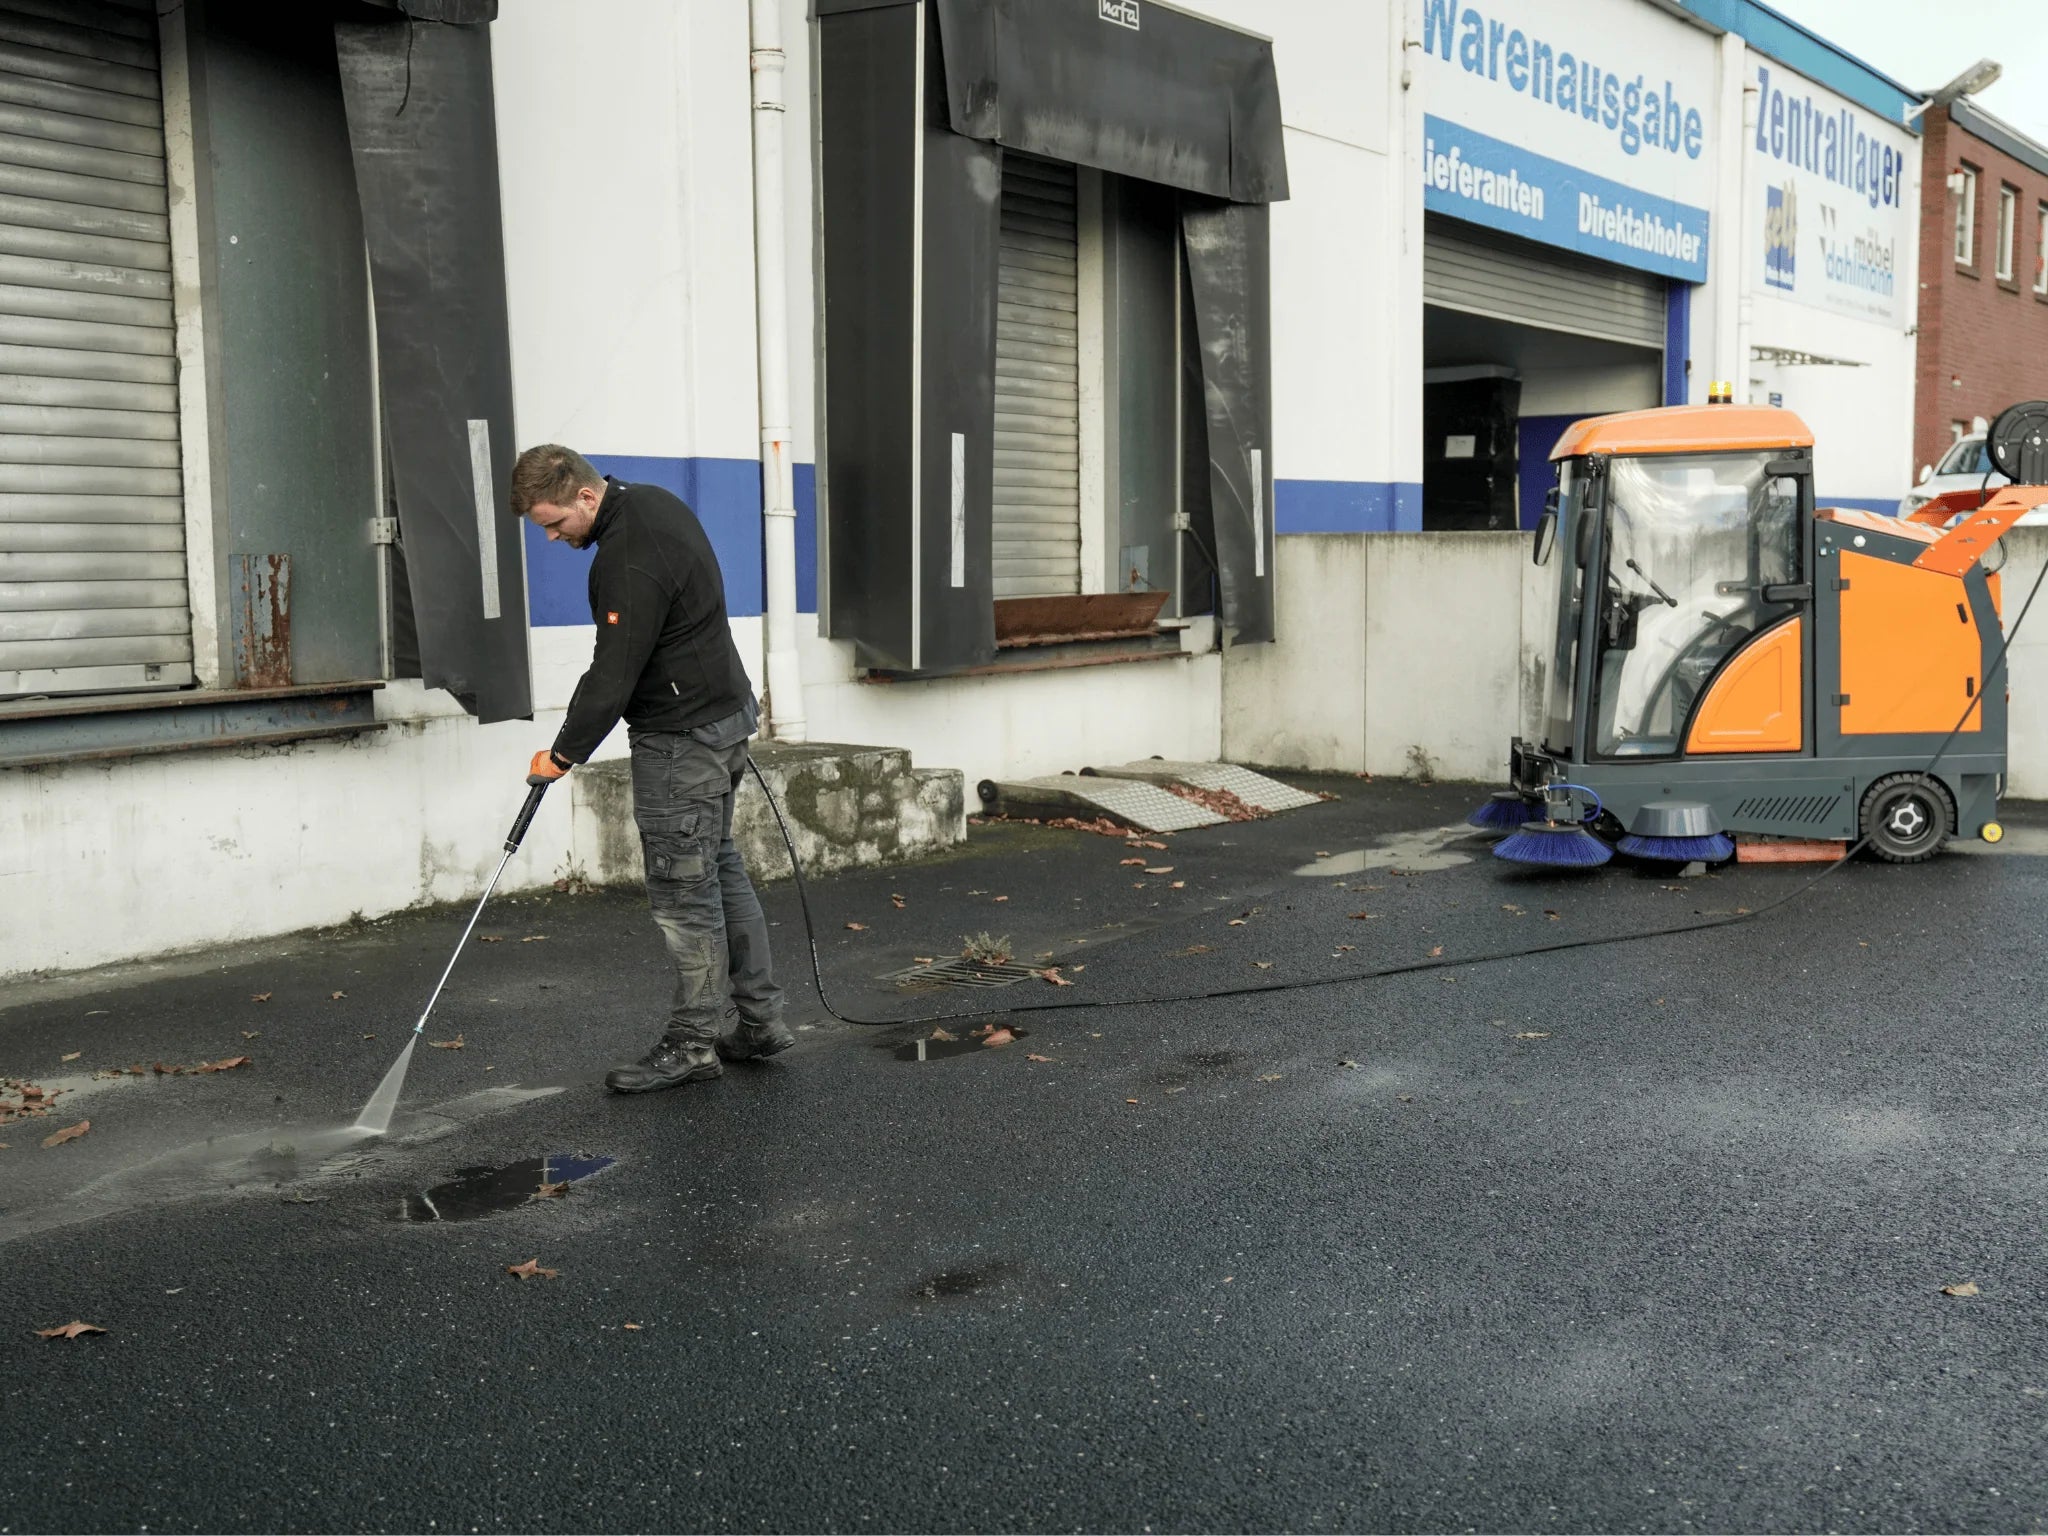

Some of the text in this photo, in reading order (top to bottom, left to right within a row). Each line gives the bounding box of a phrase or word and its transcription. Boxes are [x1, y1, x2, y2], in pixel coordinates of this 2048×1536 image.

[1423, 138, 1701, 264] ieferanten Direktabholer
[1756, 65, 1902, 209] Zentrallager
